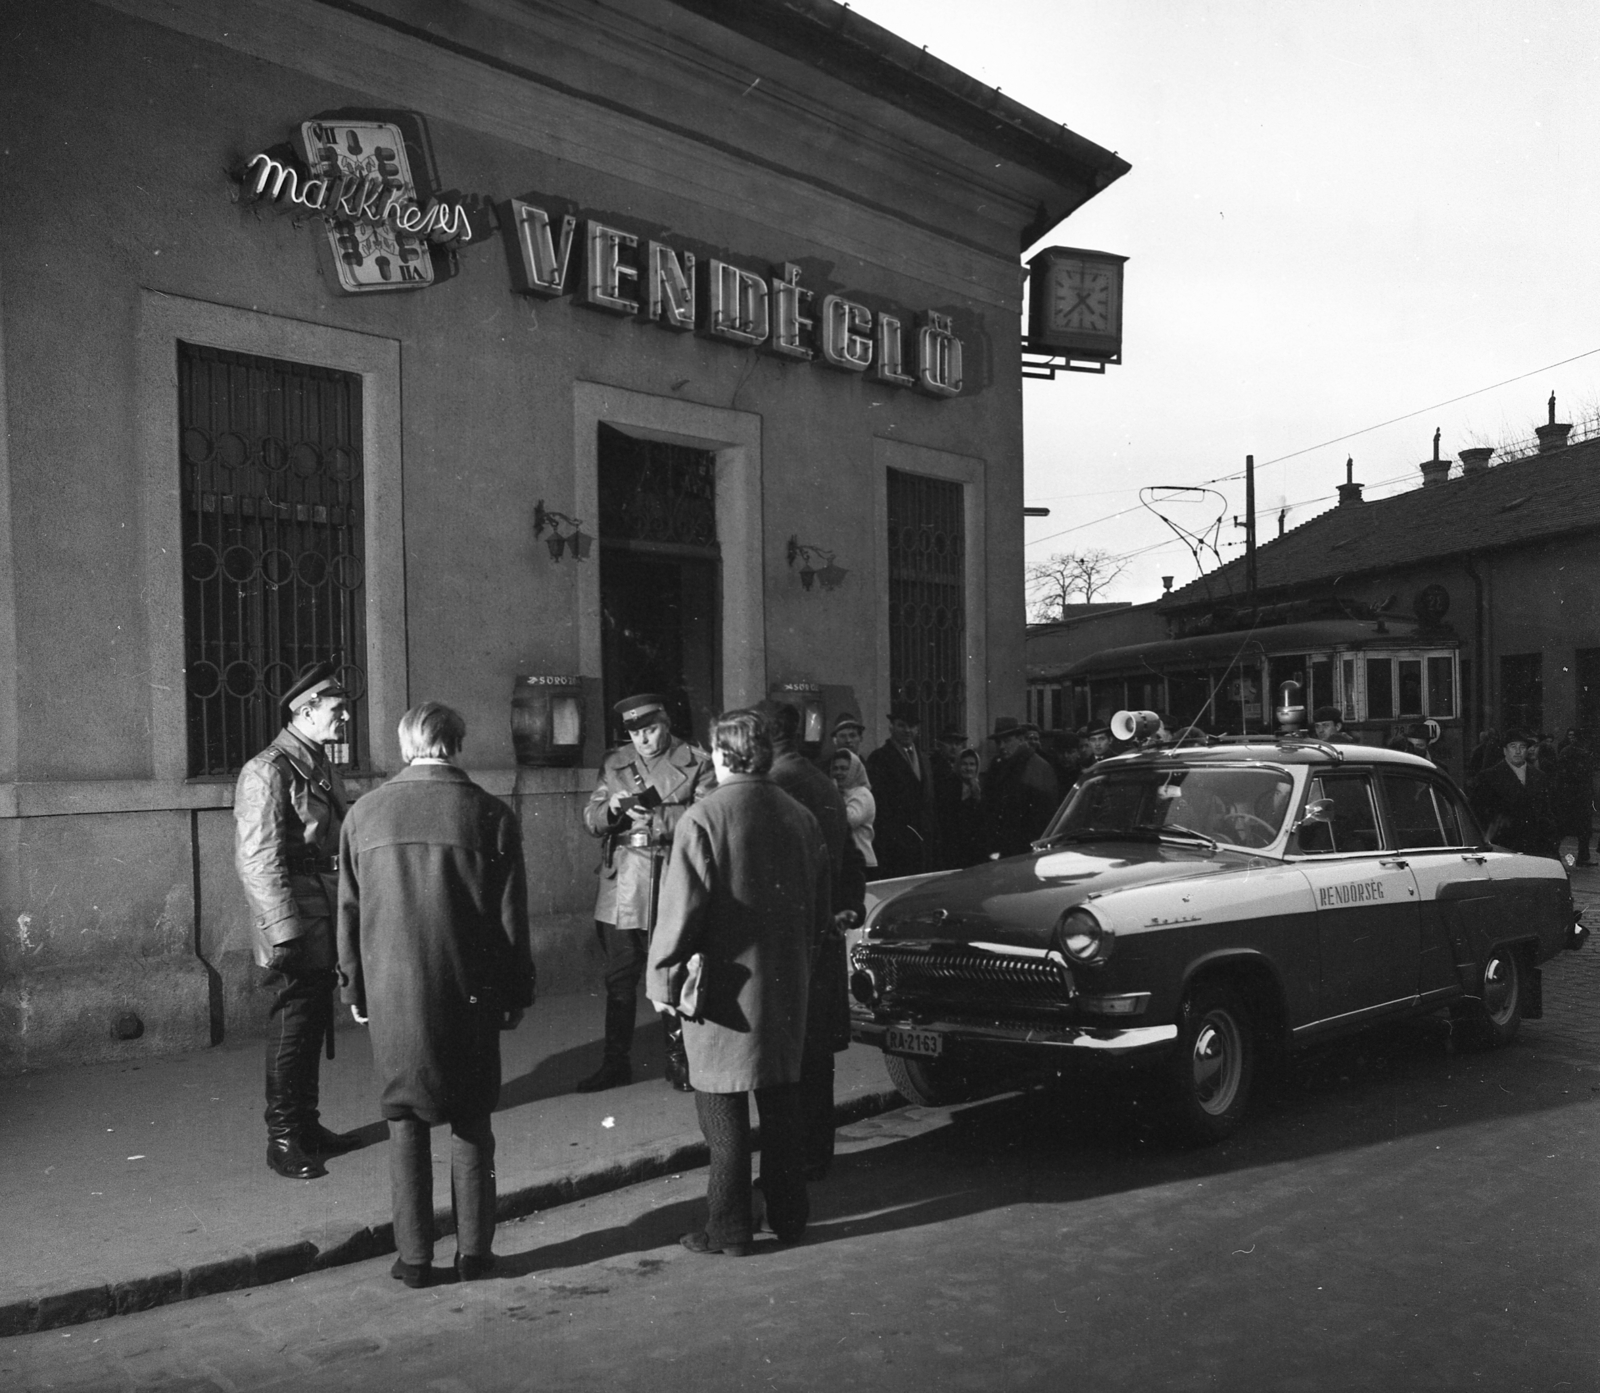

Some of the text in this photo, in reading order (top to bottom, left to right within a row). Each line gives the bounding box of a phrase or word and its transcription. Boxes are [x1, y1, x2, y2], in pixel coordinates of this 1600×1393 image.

[313, 125, 338, 144] VII
[399, 265, 426, 281] VII
[511, 198, 963, 398] VENDÉGLŐ
